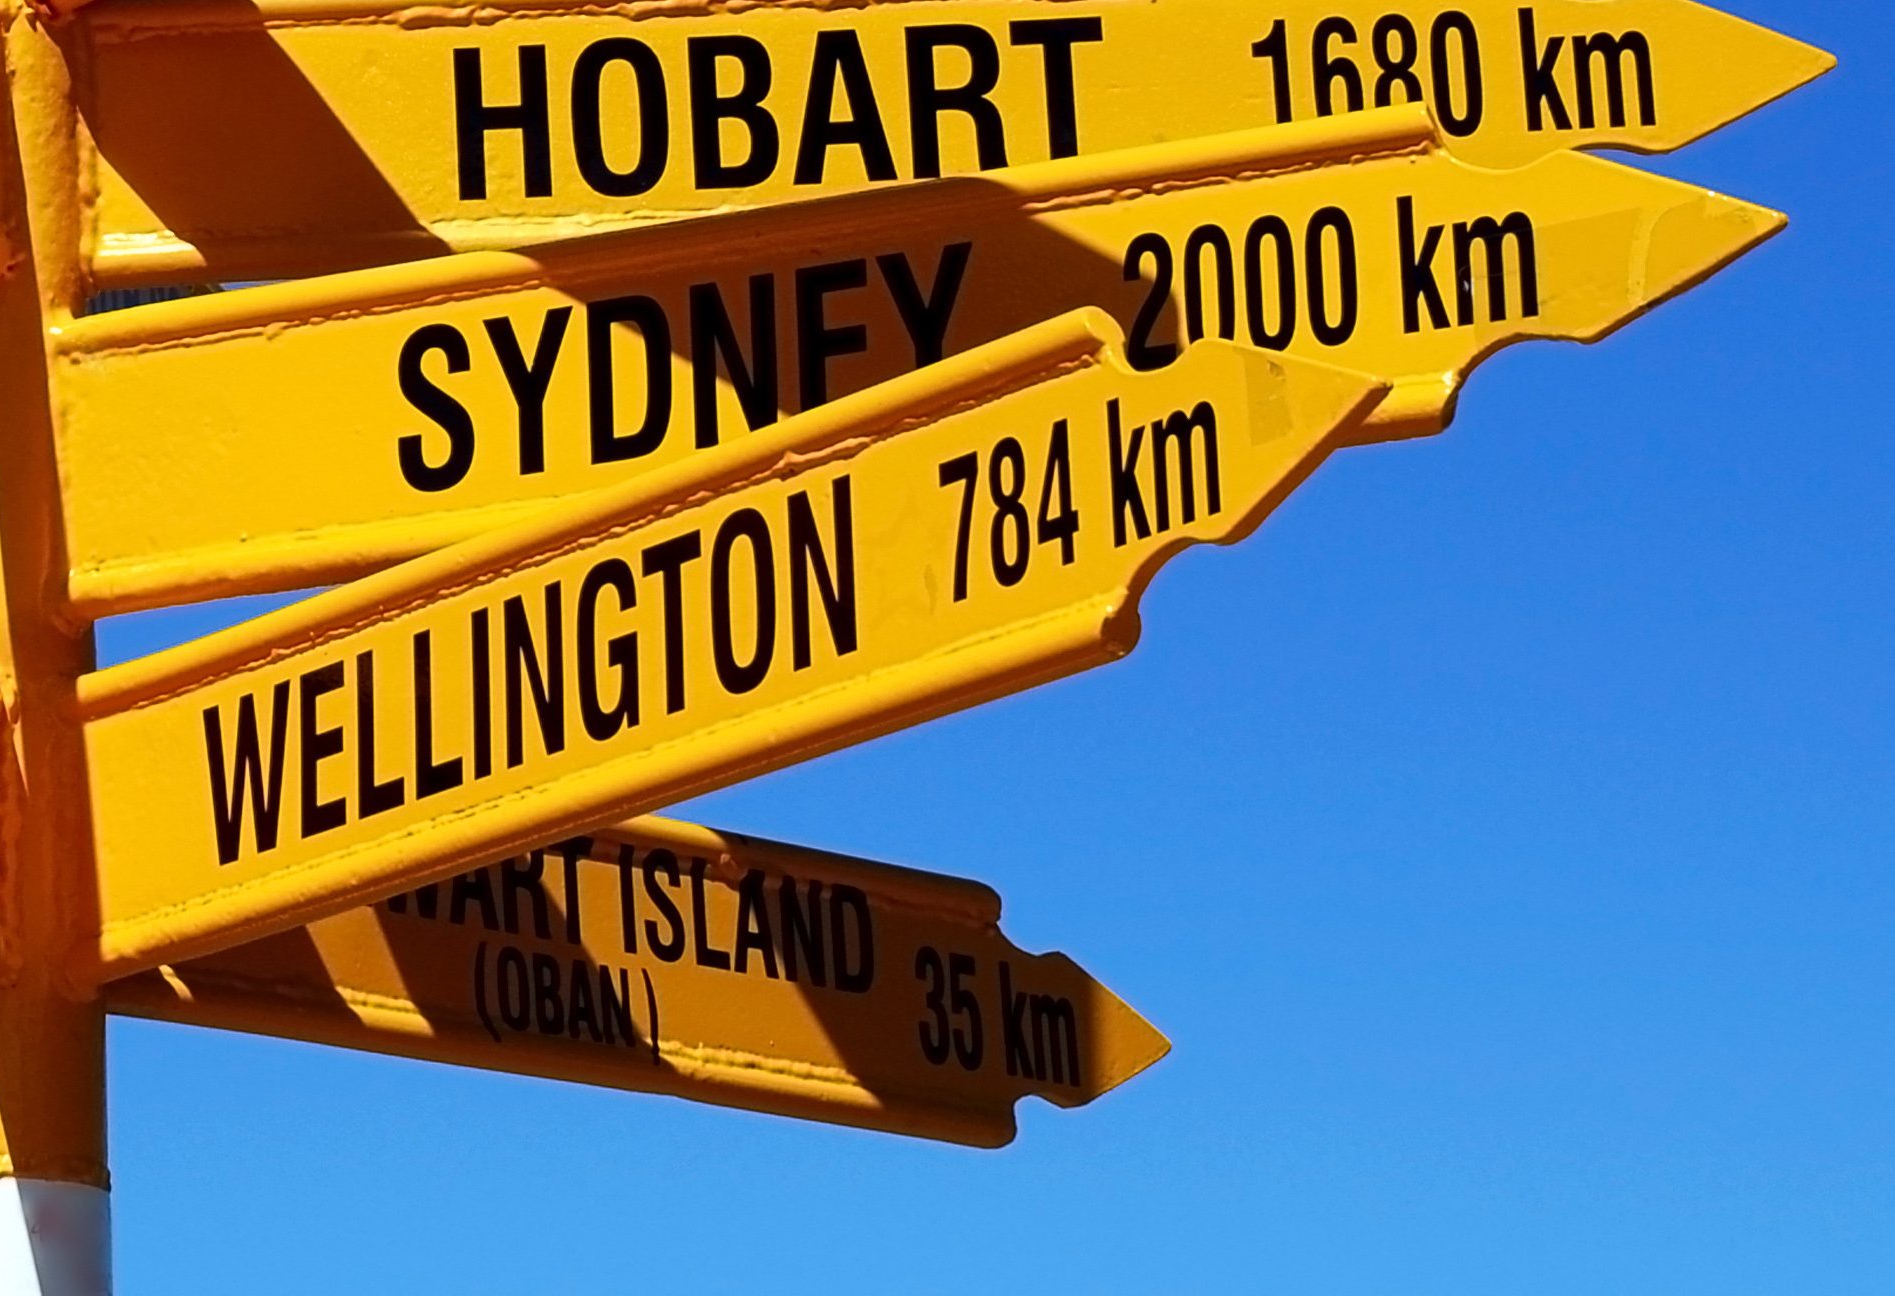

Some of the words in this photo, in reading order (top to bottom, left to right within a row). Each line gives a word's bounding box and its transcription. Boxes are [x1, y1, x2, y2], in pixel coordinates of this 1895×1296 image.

[453, 16, 1103, 202] HOBART
[1251, 9, 1482, 138] 1680
[1519, 6, 1658, 133] km
[397, 240, 974, 494] SYDNEY
[1123, 205, 1359, 371] 2000
[1396, 195, 1540, 335] km
[204, 474, 859, 867] WELLINGTON
[938, 417, 1080, 604] 784
[1106, 398, 1222, 549] km
[474, 941, 661, 1066] (OBAN)
[618, 843, 875, 994] ISLAND
[915, 947, 983, 1071] 35
[1000, 962, 1081, 1086] km
